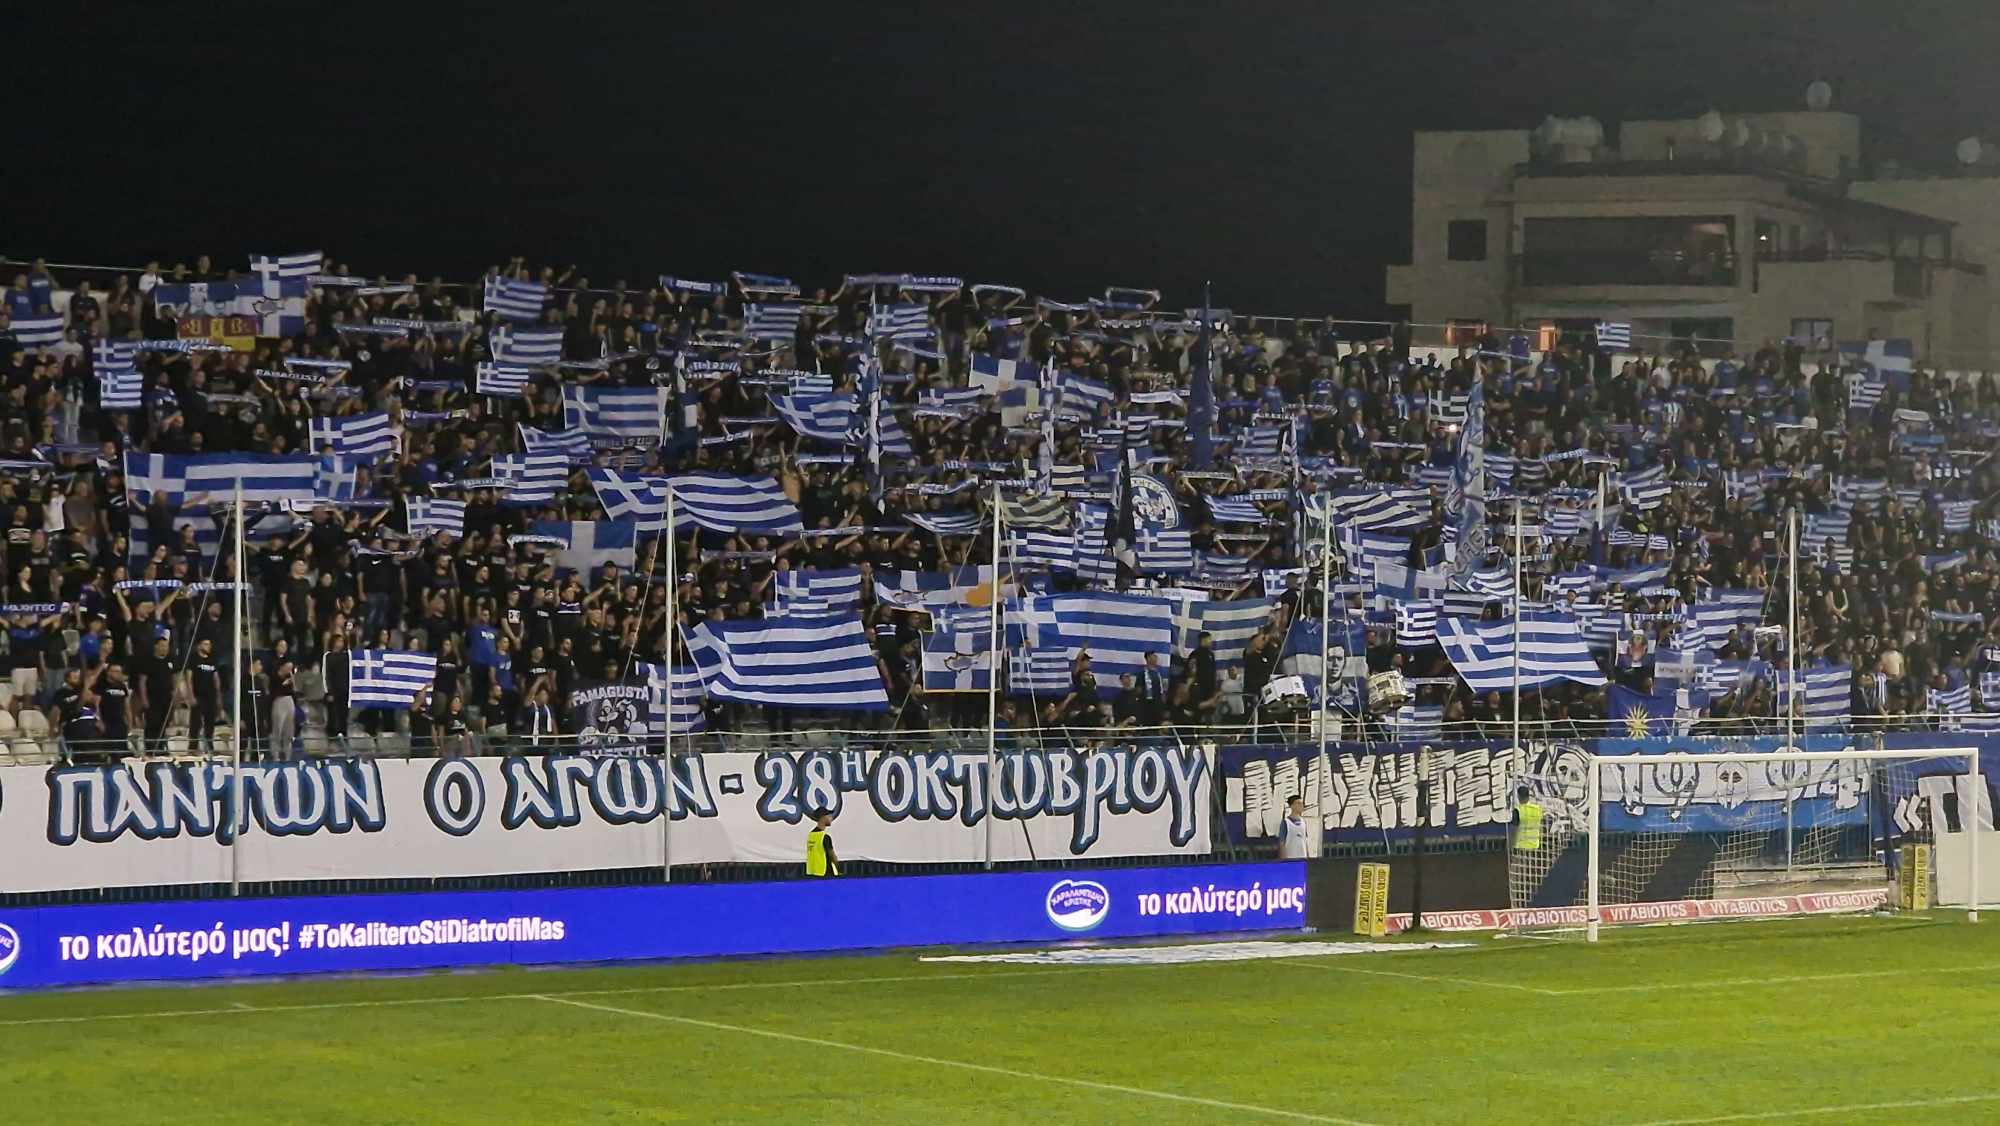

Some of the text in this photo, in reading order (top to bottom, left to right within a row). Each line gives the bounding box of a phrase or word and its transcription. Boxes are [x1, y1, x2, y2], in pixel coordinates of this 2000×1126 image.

[573, 686, 649, 706] FAMAGUSTA
[423, 760, 486, 836] Ο
[1138, 893, 1161, 915] το
[1166, 882, 1262, 916] καλύτερό
[1710, 899, 1788, 915] VITABIOTICS
[1813, 892, 1887, 909] VITABIOTICS
[1508, 909, 1587, 926] VITABIOTICS
[1610, 904, 1687, 922] VITABIOTICS
[59, 917, 565, 961] το καλύτερό μας! #ToKaliteroStiDiatrofiMas
